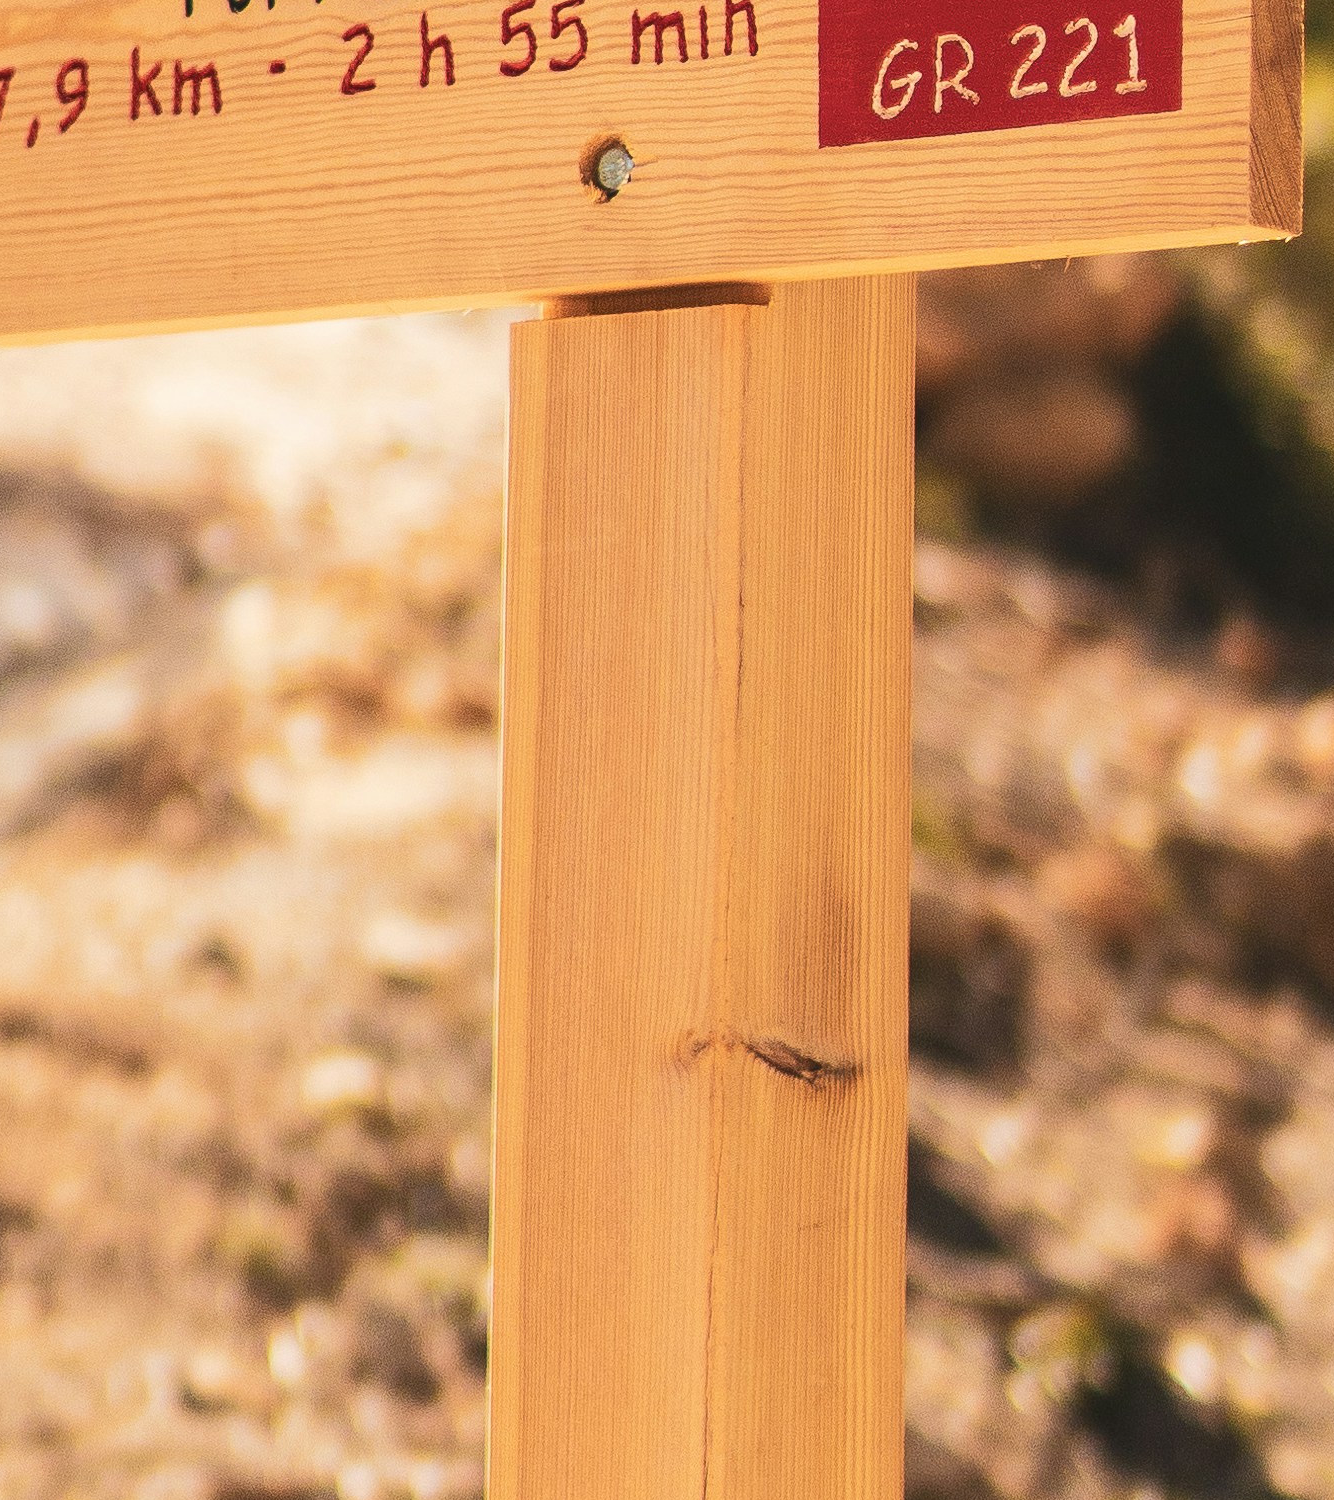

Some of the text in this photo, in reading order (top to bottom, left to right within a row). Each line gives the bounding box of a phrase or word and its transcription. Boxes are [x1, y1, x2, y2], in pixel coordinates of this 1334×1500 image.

[129, 47, 224, 121] km
[341, 24, 377, 95] 2
[418, 11, 456, 88] h
[871, 14, 1147, 119] GR 221
